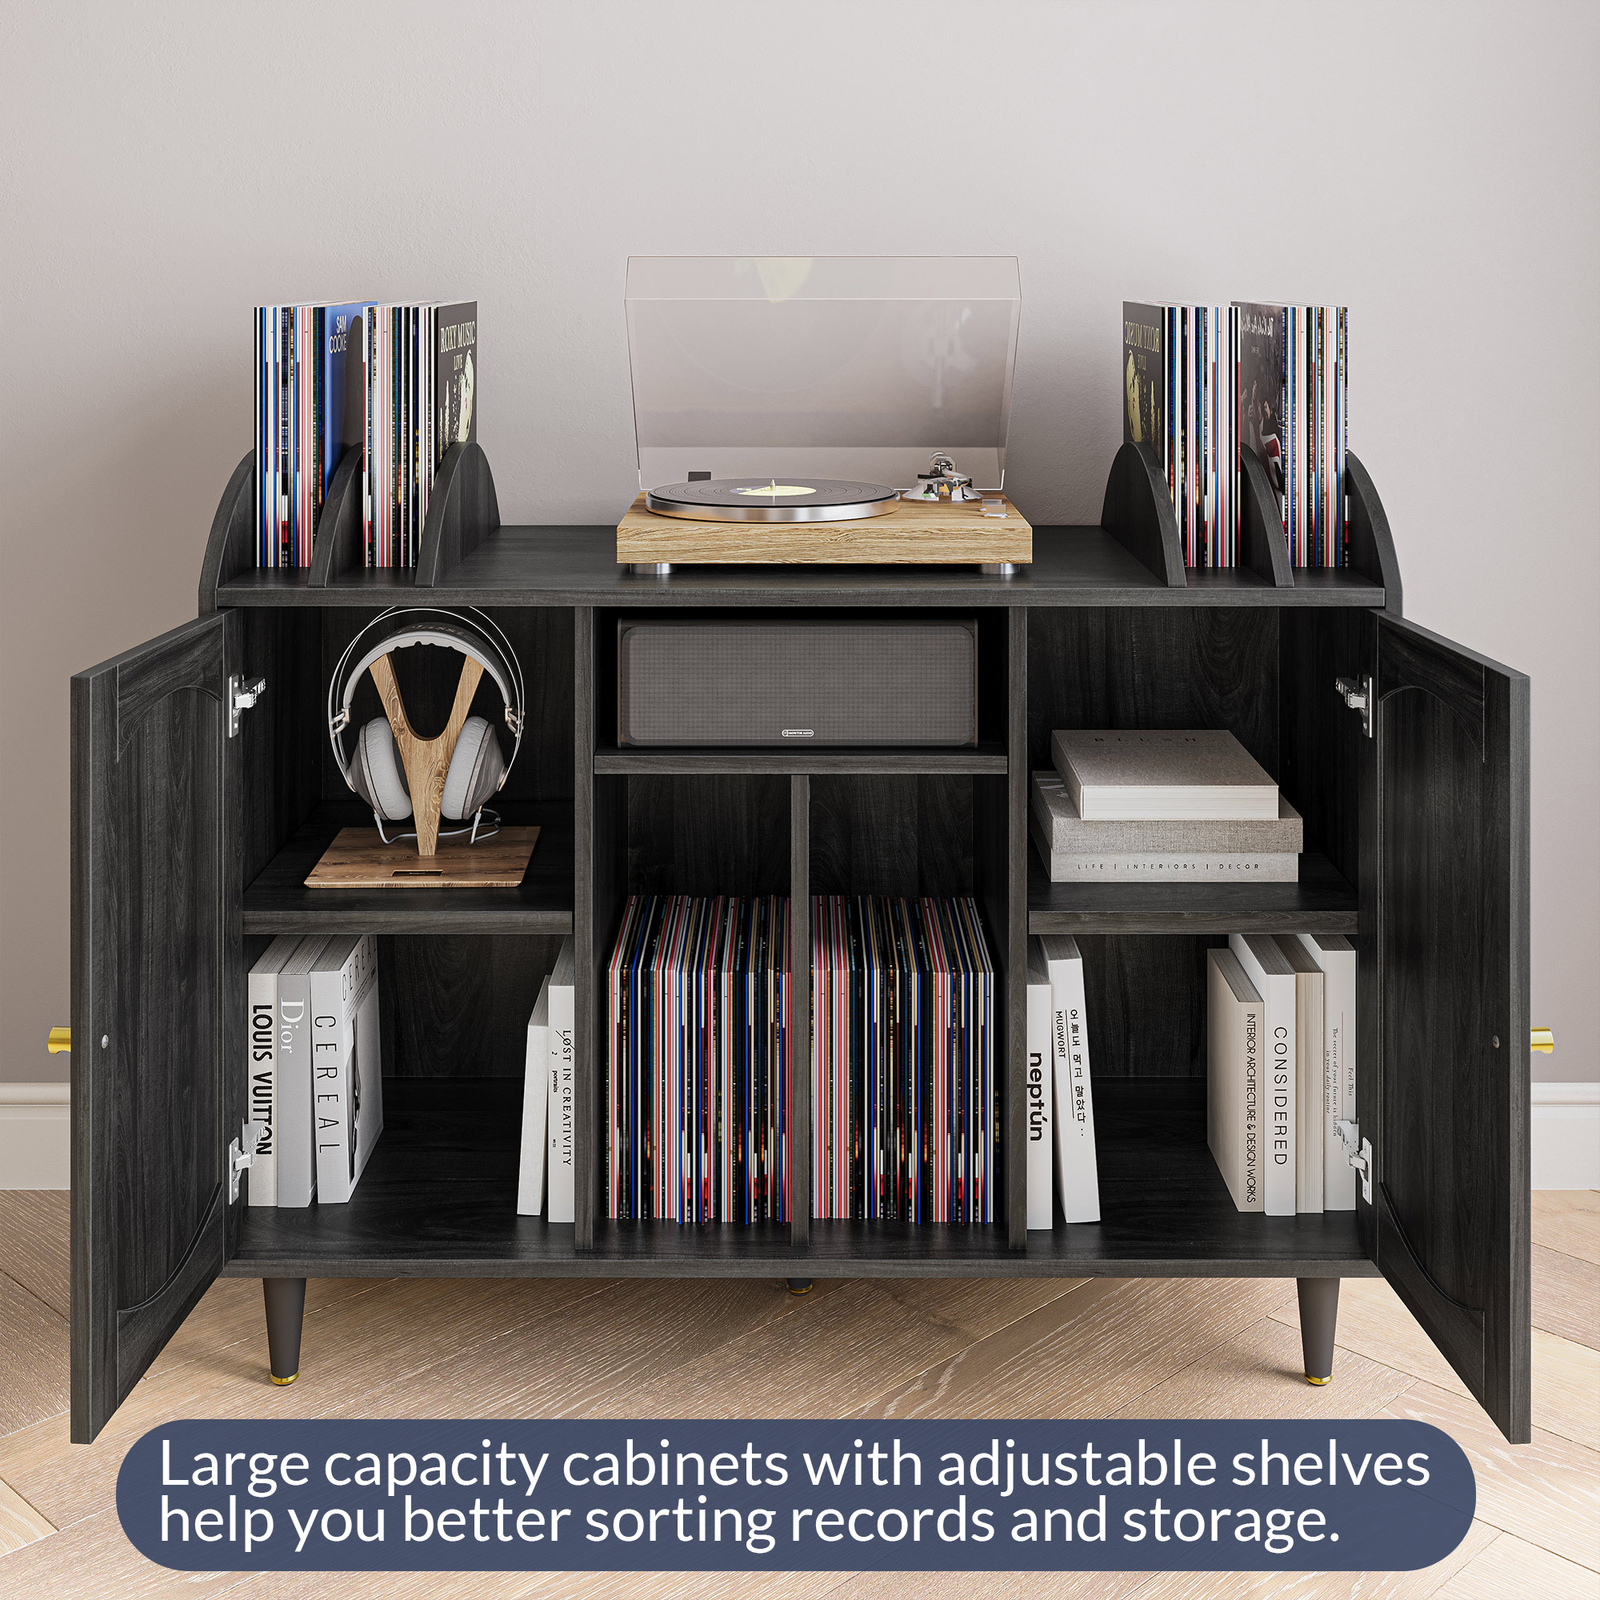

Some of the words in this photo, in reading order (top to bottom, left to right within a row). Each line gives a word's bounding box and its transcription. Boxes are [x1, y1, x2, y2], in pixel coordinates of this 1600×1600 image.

[328, 334, 347, 354] COOKE
[336, 315, 347, 334] SAM
[440, 324, 457, 353] ROXY
[458, 320, 476, 349] MUSIC
[252, 1004, 273, 1062] LOUIS
[280, 997, 305, 1054] Dior
[1055, 1010, 1066, 1059] MUGWORT
[1246, 1013, 1257, 1054] INTERIOR
[314, 1015, 341, 1153] CEREAL
[562, 1067, 572, 1081] IN
[1246, 1055, 1257, 1122] ARCHITECTURE
[1273, 1026, 1288, 1166] CONSIDERED
[1027, 1052, 1048, 1142] neptún
[562, 1086, 572, 1166] CREATIVITY
[1246, 1123, 1257, 1131] &
[1246, 1132, 1257, 1167] DESIGN
[1246, 1168, 1257, 1204] WORKS
